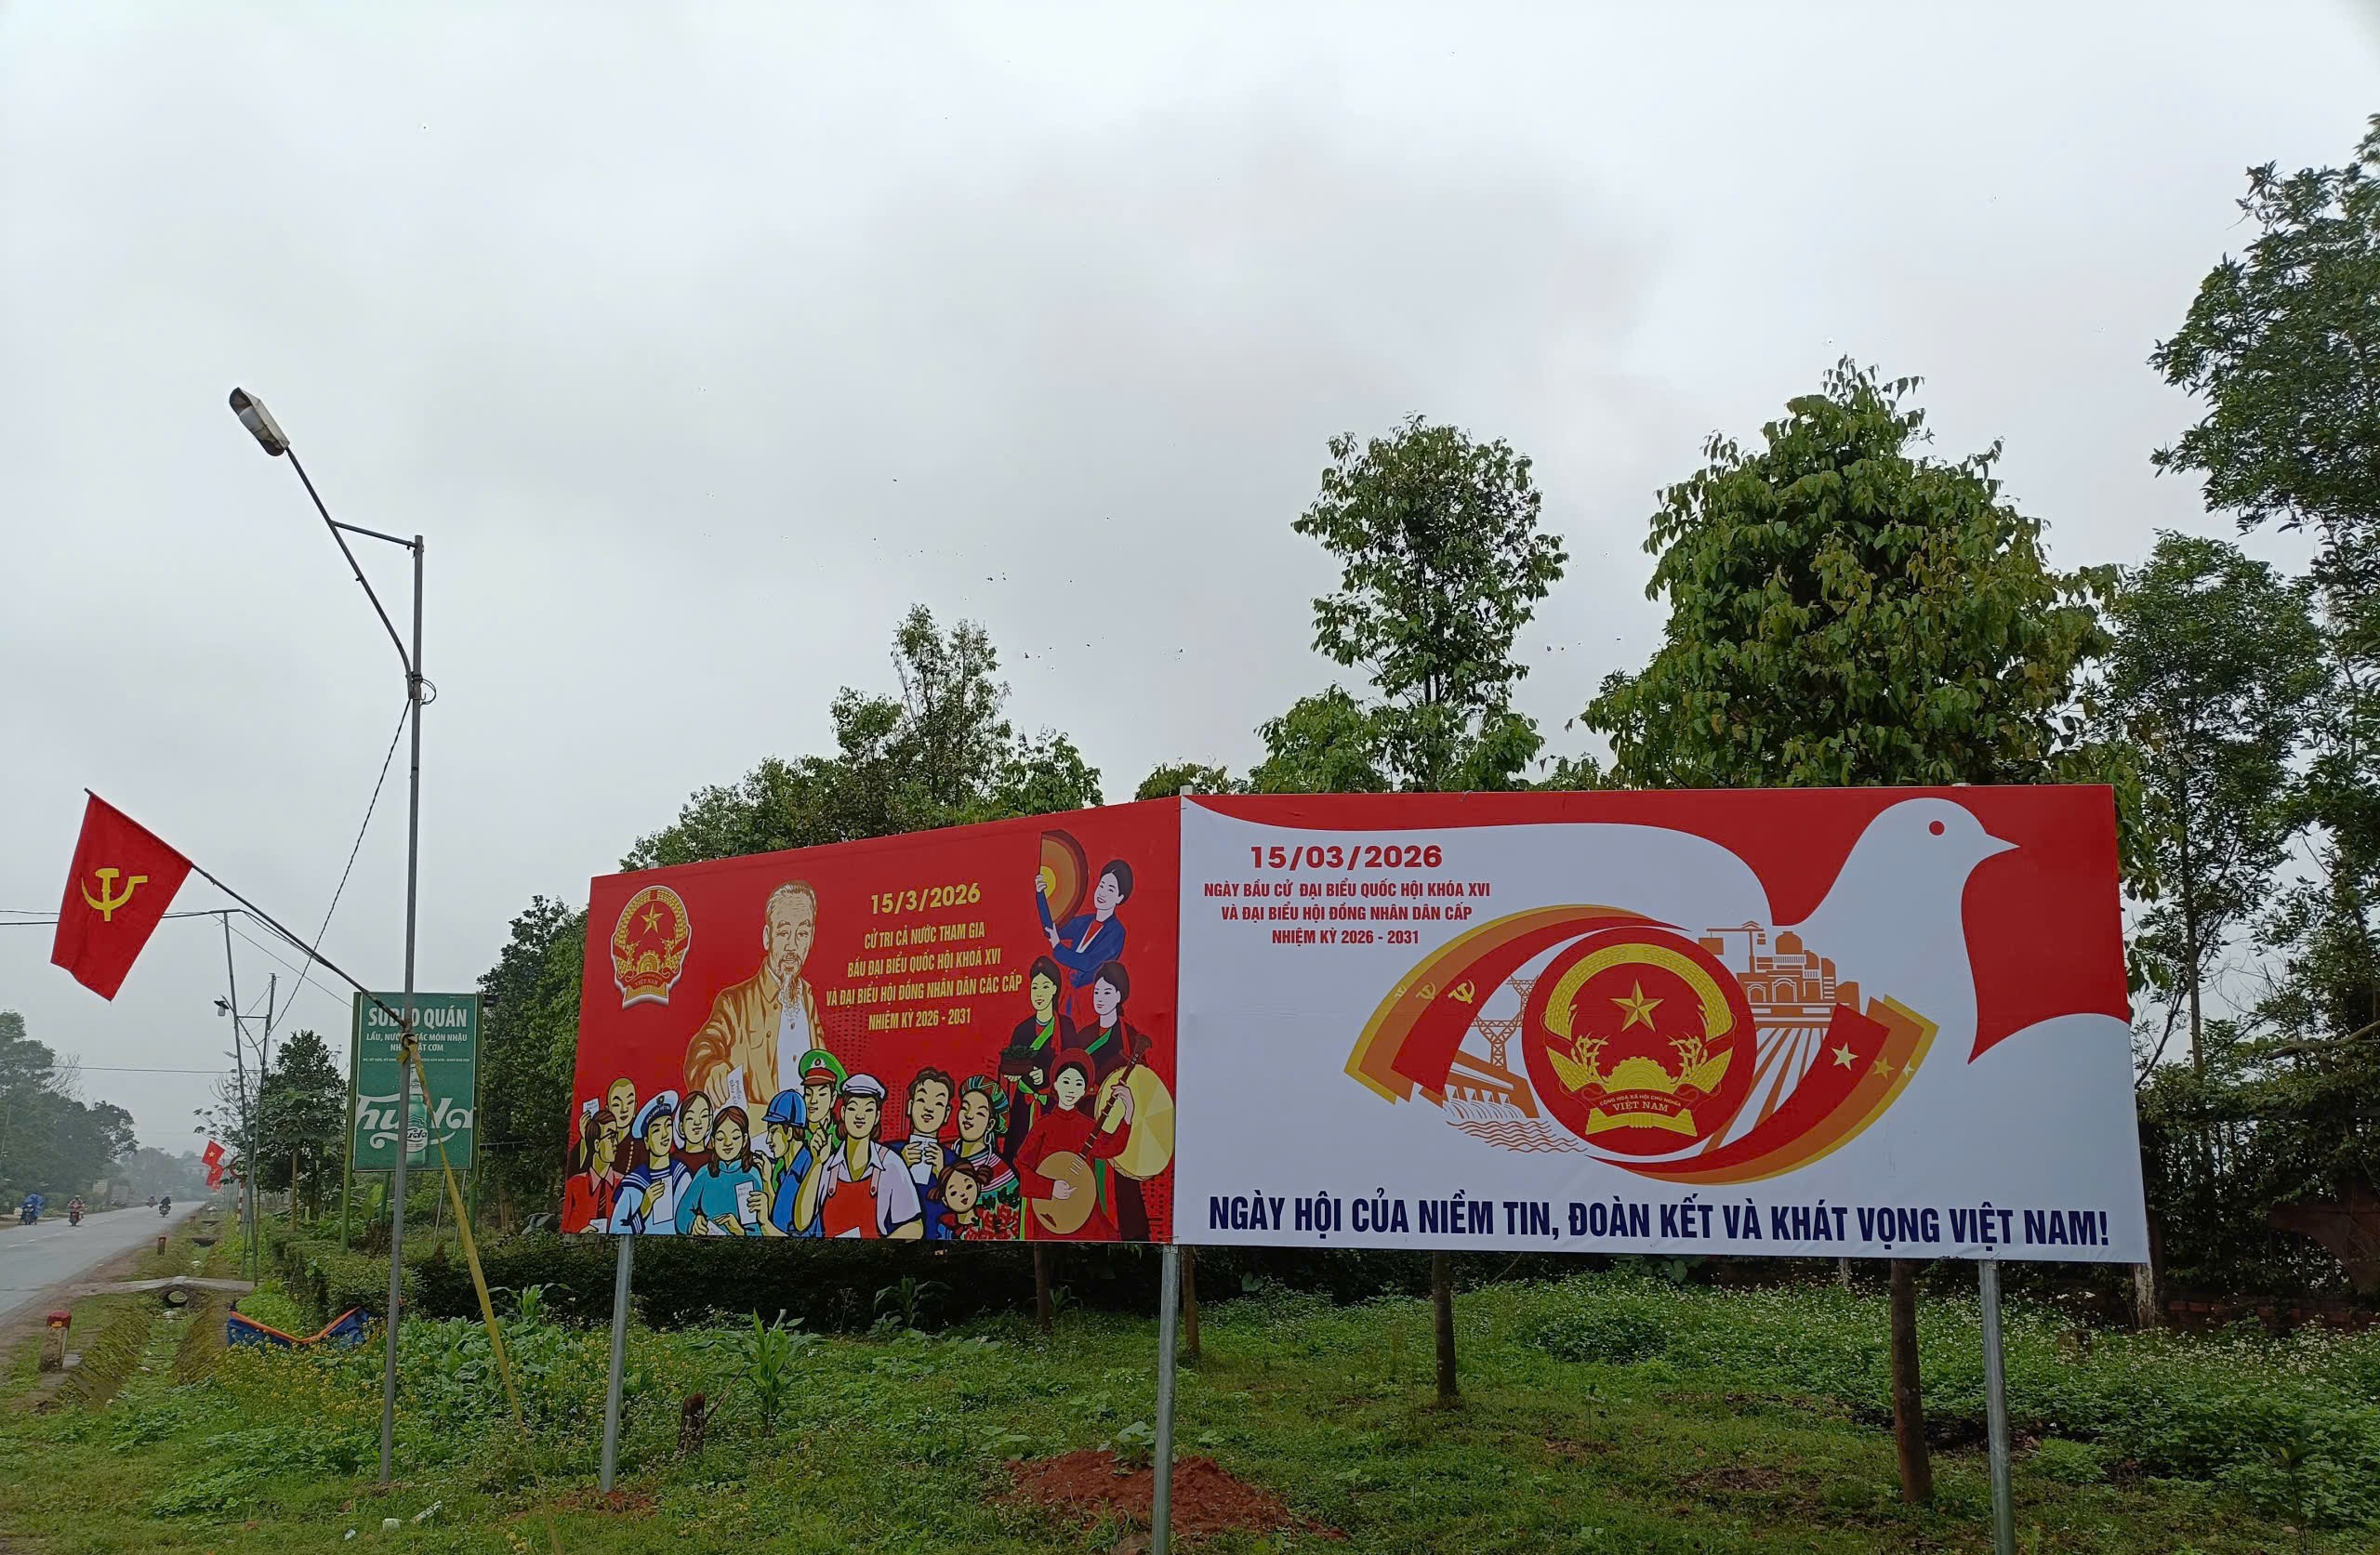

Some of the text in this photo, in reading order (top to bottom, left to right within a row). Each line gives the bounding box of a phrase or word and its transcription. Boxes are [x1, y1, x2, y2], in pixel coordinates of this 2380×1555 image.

[1250, 844, 1443, 871] 15/03/2026
[871, 883, 981, 915] 15/3/2026
[1204, 877, 1490, 900] NGÀY BẦU CỬ ĐẠI BIỂU QUỐC HỘI KHÓA XVI
[1222, 901, 1473, 923] VÀ ĐẠI BIỂU HỘI ĐỒNG NHÂN DÂN CẤP
[865, 921, 985, 949] CỬ TRI CẢ NƯỚC THAM GIA
[1272, 928, 1316, 946] NHIỆM
[1320, 927, 1338, 943] KỲ
[1341, 930, 1374, 944] 2026
[1387, 930, 1419, 943] 2031
[848, 946, 1001, 978] BẦU ĐẠI BIỂU QUỐC HỘI KHOÁ XVI
[826, 969, 1023, 1008] VÀ ĐẠI BIỂU HỘI ĐỒNG NHÂN DÂN CÁC CẤP
[423, 1004, 467, 1029] QUÁN
[868, 1010, 899, 1033] NHIỆM
[901, 1008, 914, 1028] KỲ
[916, 1010, 939, 1027] 2026
[948, 1008, 971, 1025] 2031
[429, 1032, 446, 1041] MÓN
[1612, 1100, 1669, 1112] VIỆT NAM
[1210, 1187, 2109, 1252] NGÀY HỘI CỦA NIỀM TIN, ĐOÀN KẾT VÀ KHÁT VỌNG VIỆT NAM!
